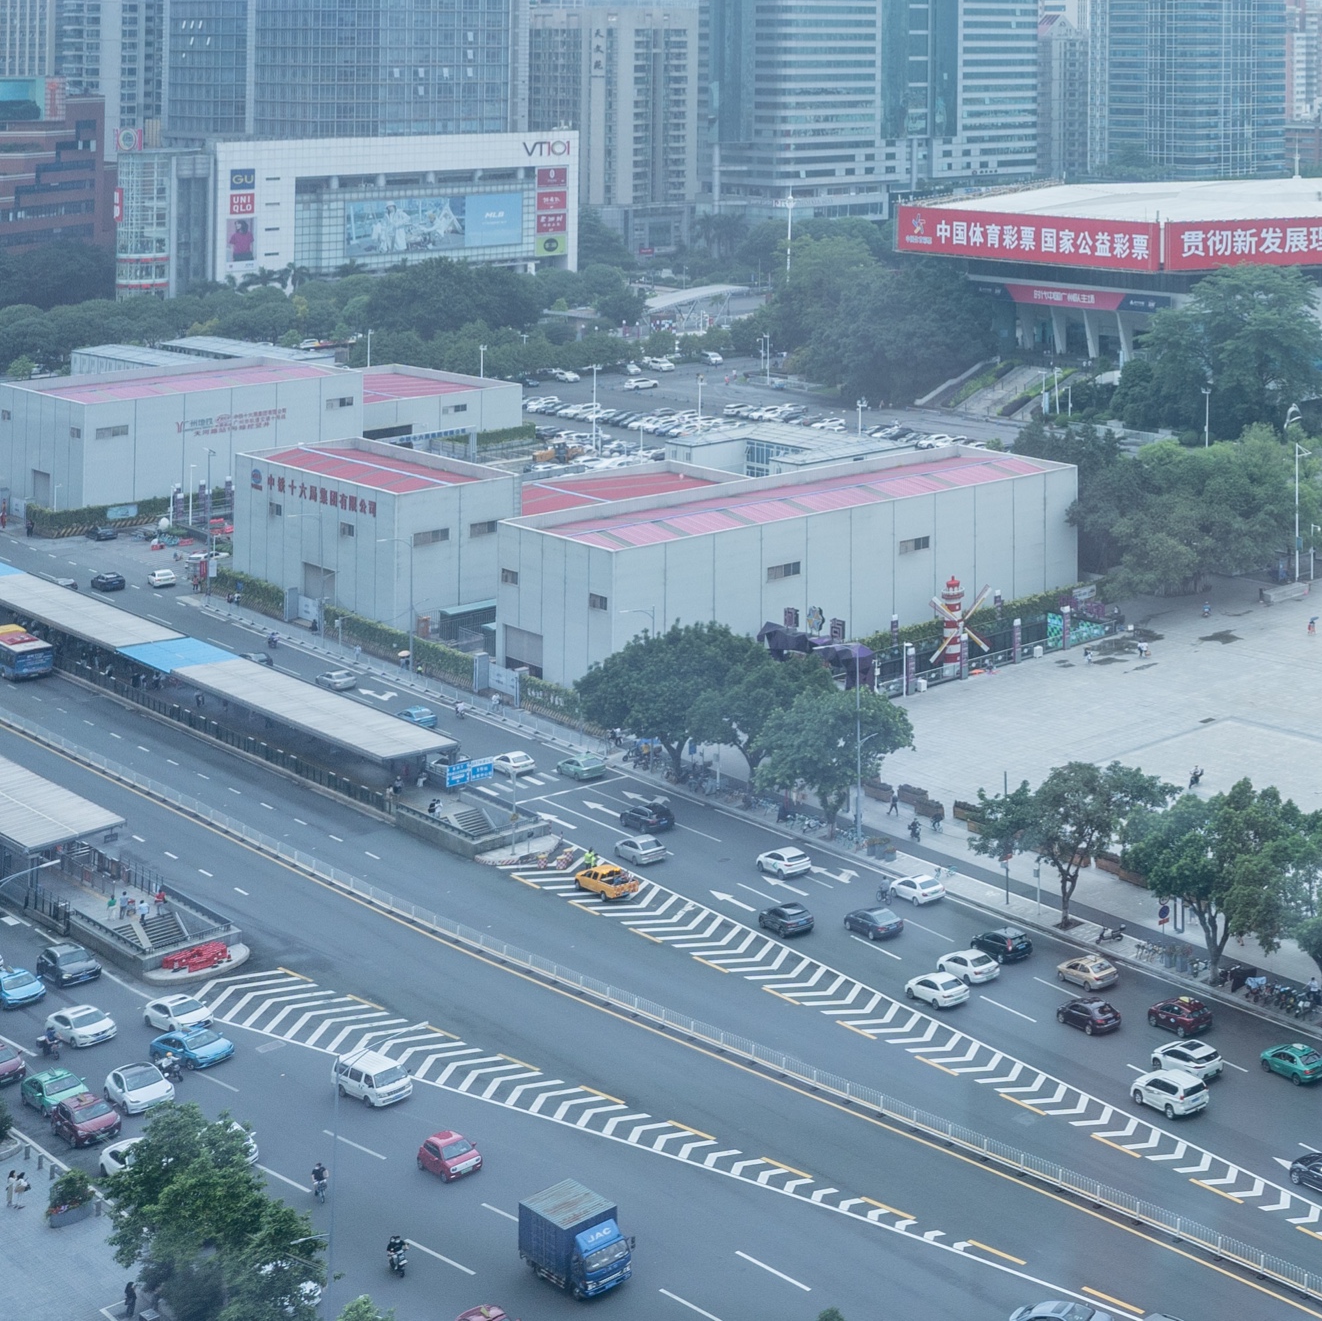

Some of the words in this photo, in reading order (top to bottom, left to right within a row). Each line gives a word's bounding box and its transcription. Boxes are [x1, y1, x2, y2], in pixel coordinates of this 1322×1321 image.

[522, 140, 571, 157] VT101
[232, 174, 254, 185] GU
[232, 195, 251, 204] UNI
[232, 203, 253, 213] QLO
[936, 220, 1036, 251] 中国体育彩票
[1040, 227, 1150, 260] 国家公益彩票
[267, 474, 377, 518] 中铁十六局集团有限公司
[586, 1227, 613, 1244] JAC
